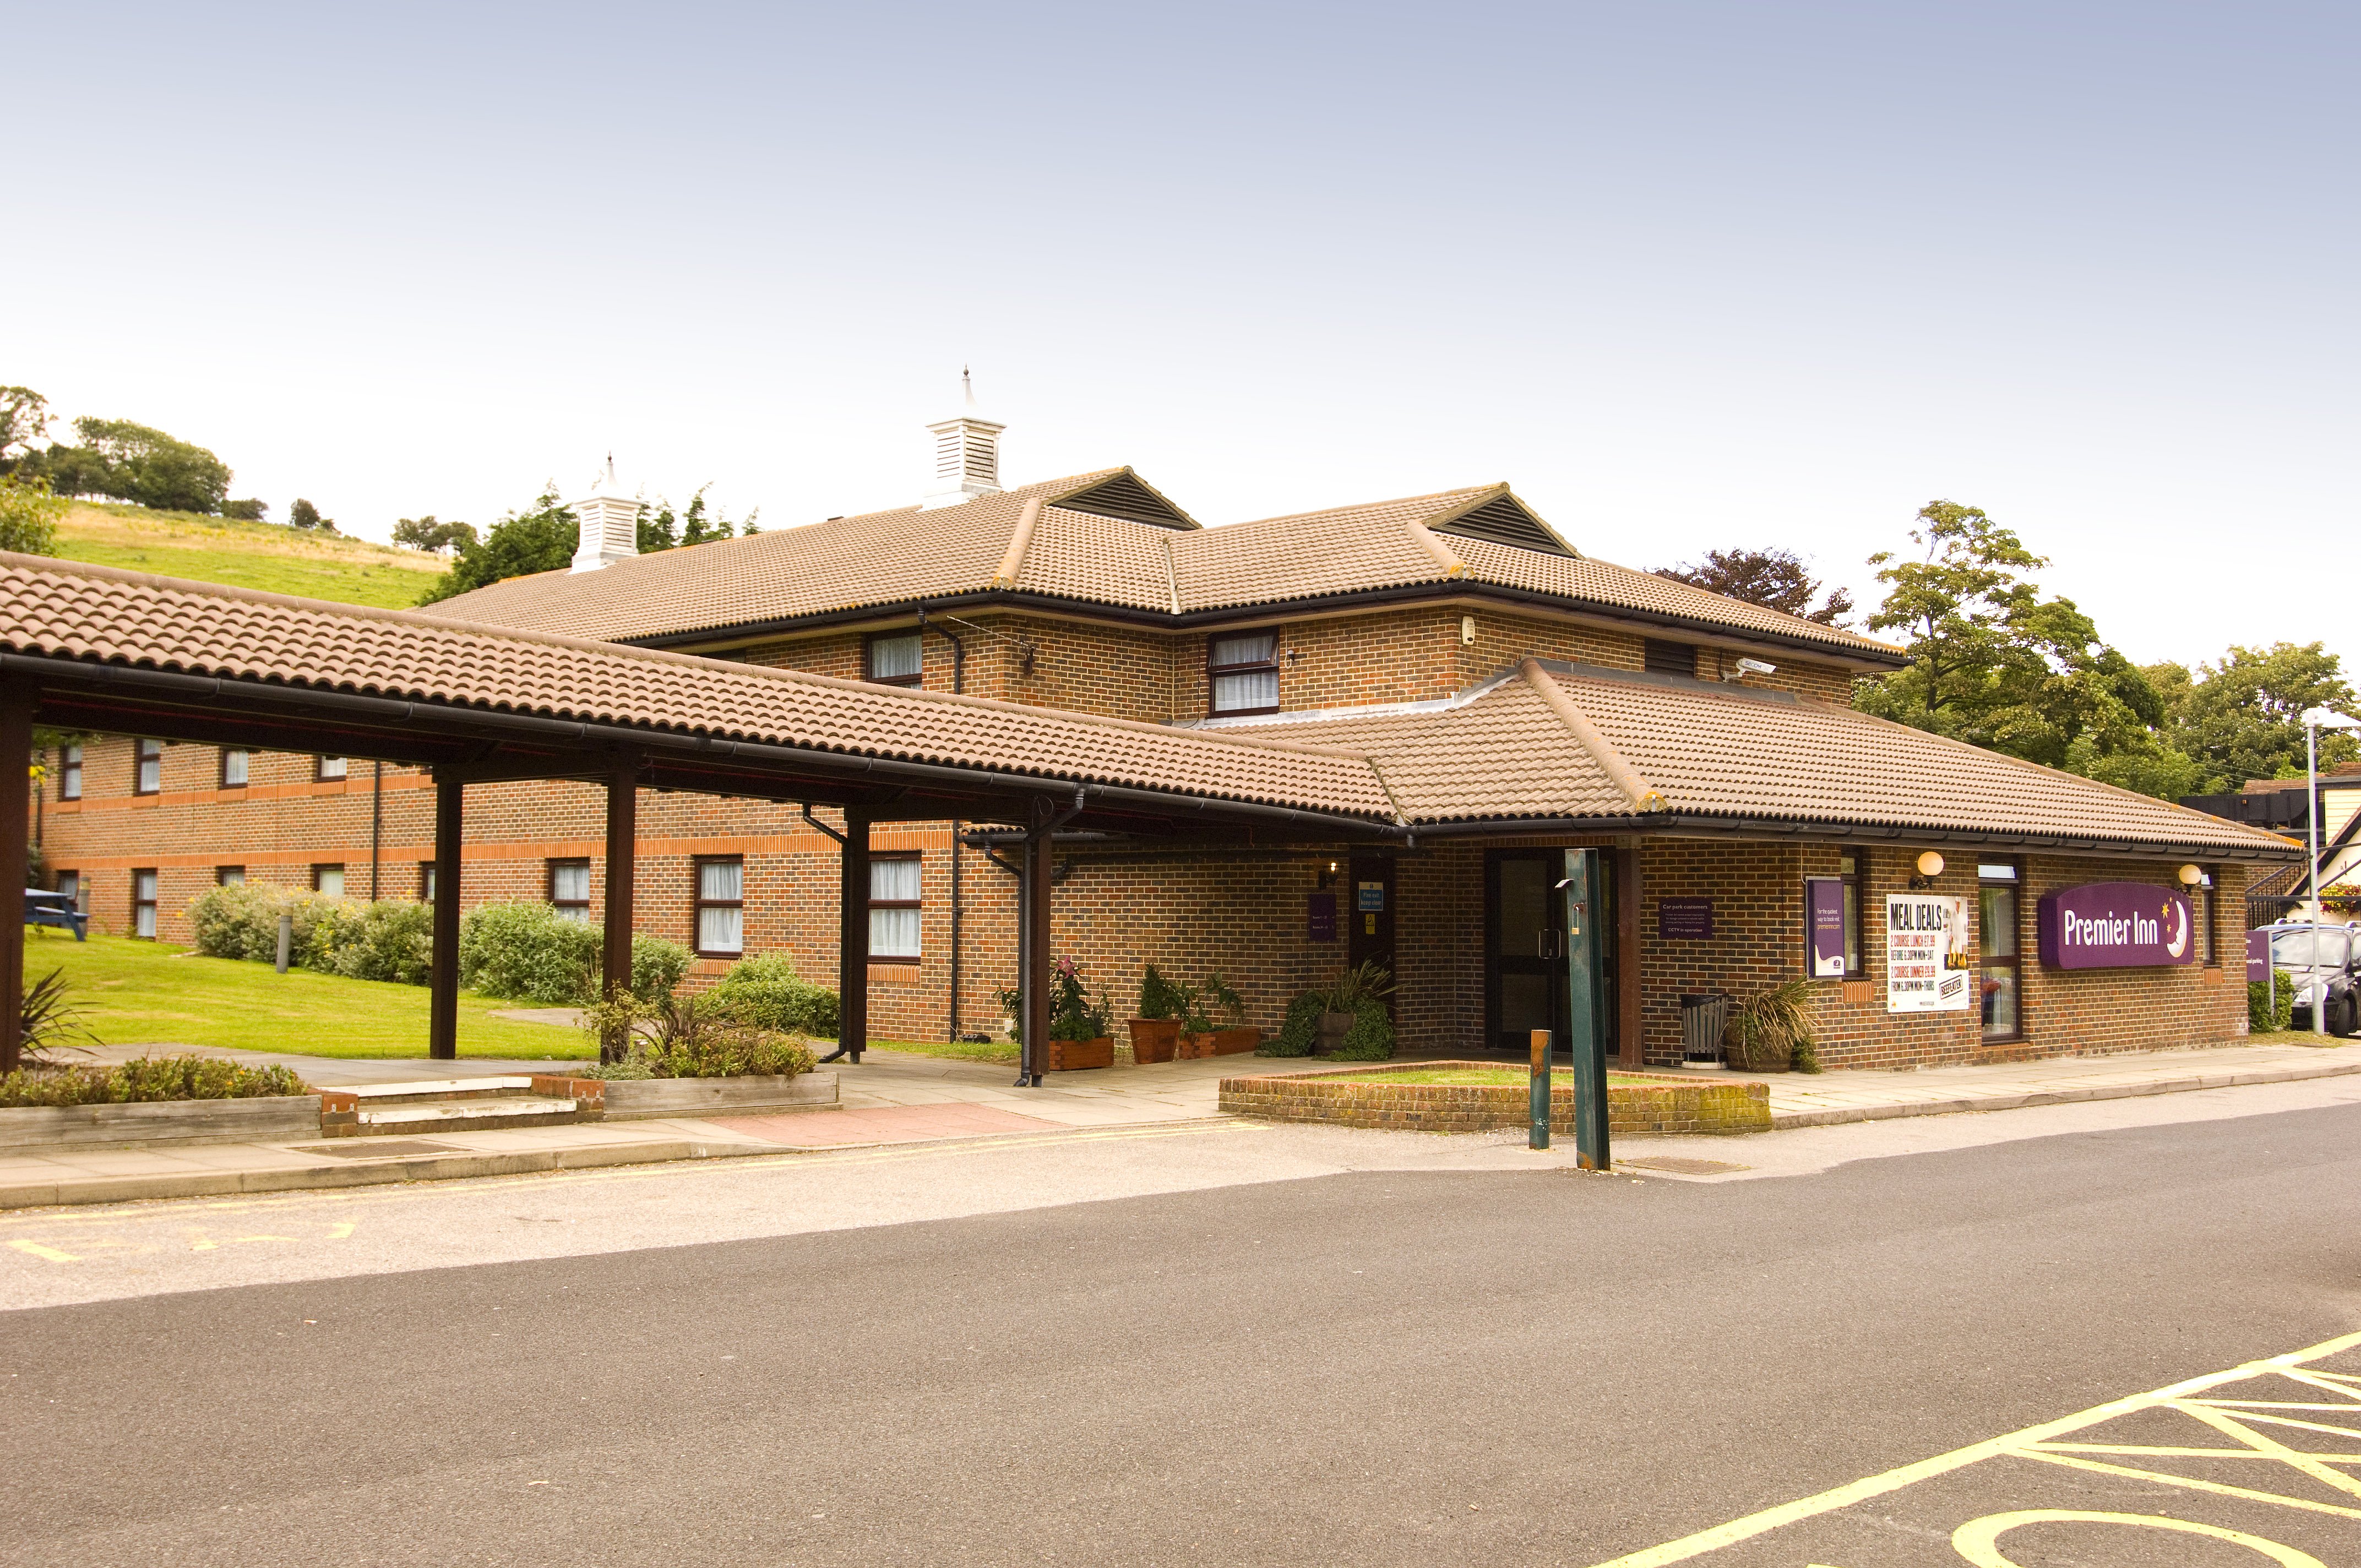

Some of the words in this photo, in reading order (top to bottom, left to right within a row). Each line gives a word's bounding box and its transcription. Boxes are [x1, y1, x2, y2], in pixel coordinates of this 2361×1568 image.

[1891, 903, 1914, 930] MEAL
[1917, 904, 1942, 930] DEALS
[2065, 910, 2130, 945] Premier
[2134, 911, 2158, 945] Inn
[1890, 935, 1893, 946] 2
[1894, 935, 1910, 946] COURSE
[1910, 935, 1923, 946] LUNCH
[1891, 950, 1903, 960] BEFORE
[1904, 950, 1917, 960] 6.30PM
[1891, 966, 1894, 978] 2
[1894, 966, 1910, 978] COURSE
[1910, 966, 1924, 978] DINNER
[1891, 981, 1900, 992] FROM
[1901, 981, 1913, 992] 6.30PM
[1941, 979, 1961, 995] BEEFEATER
